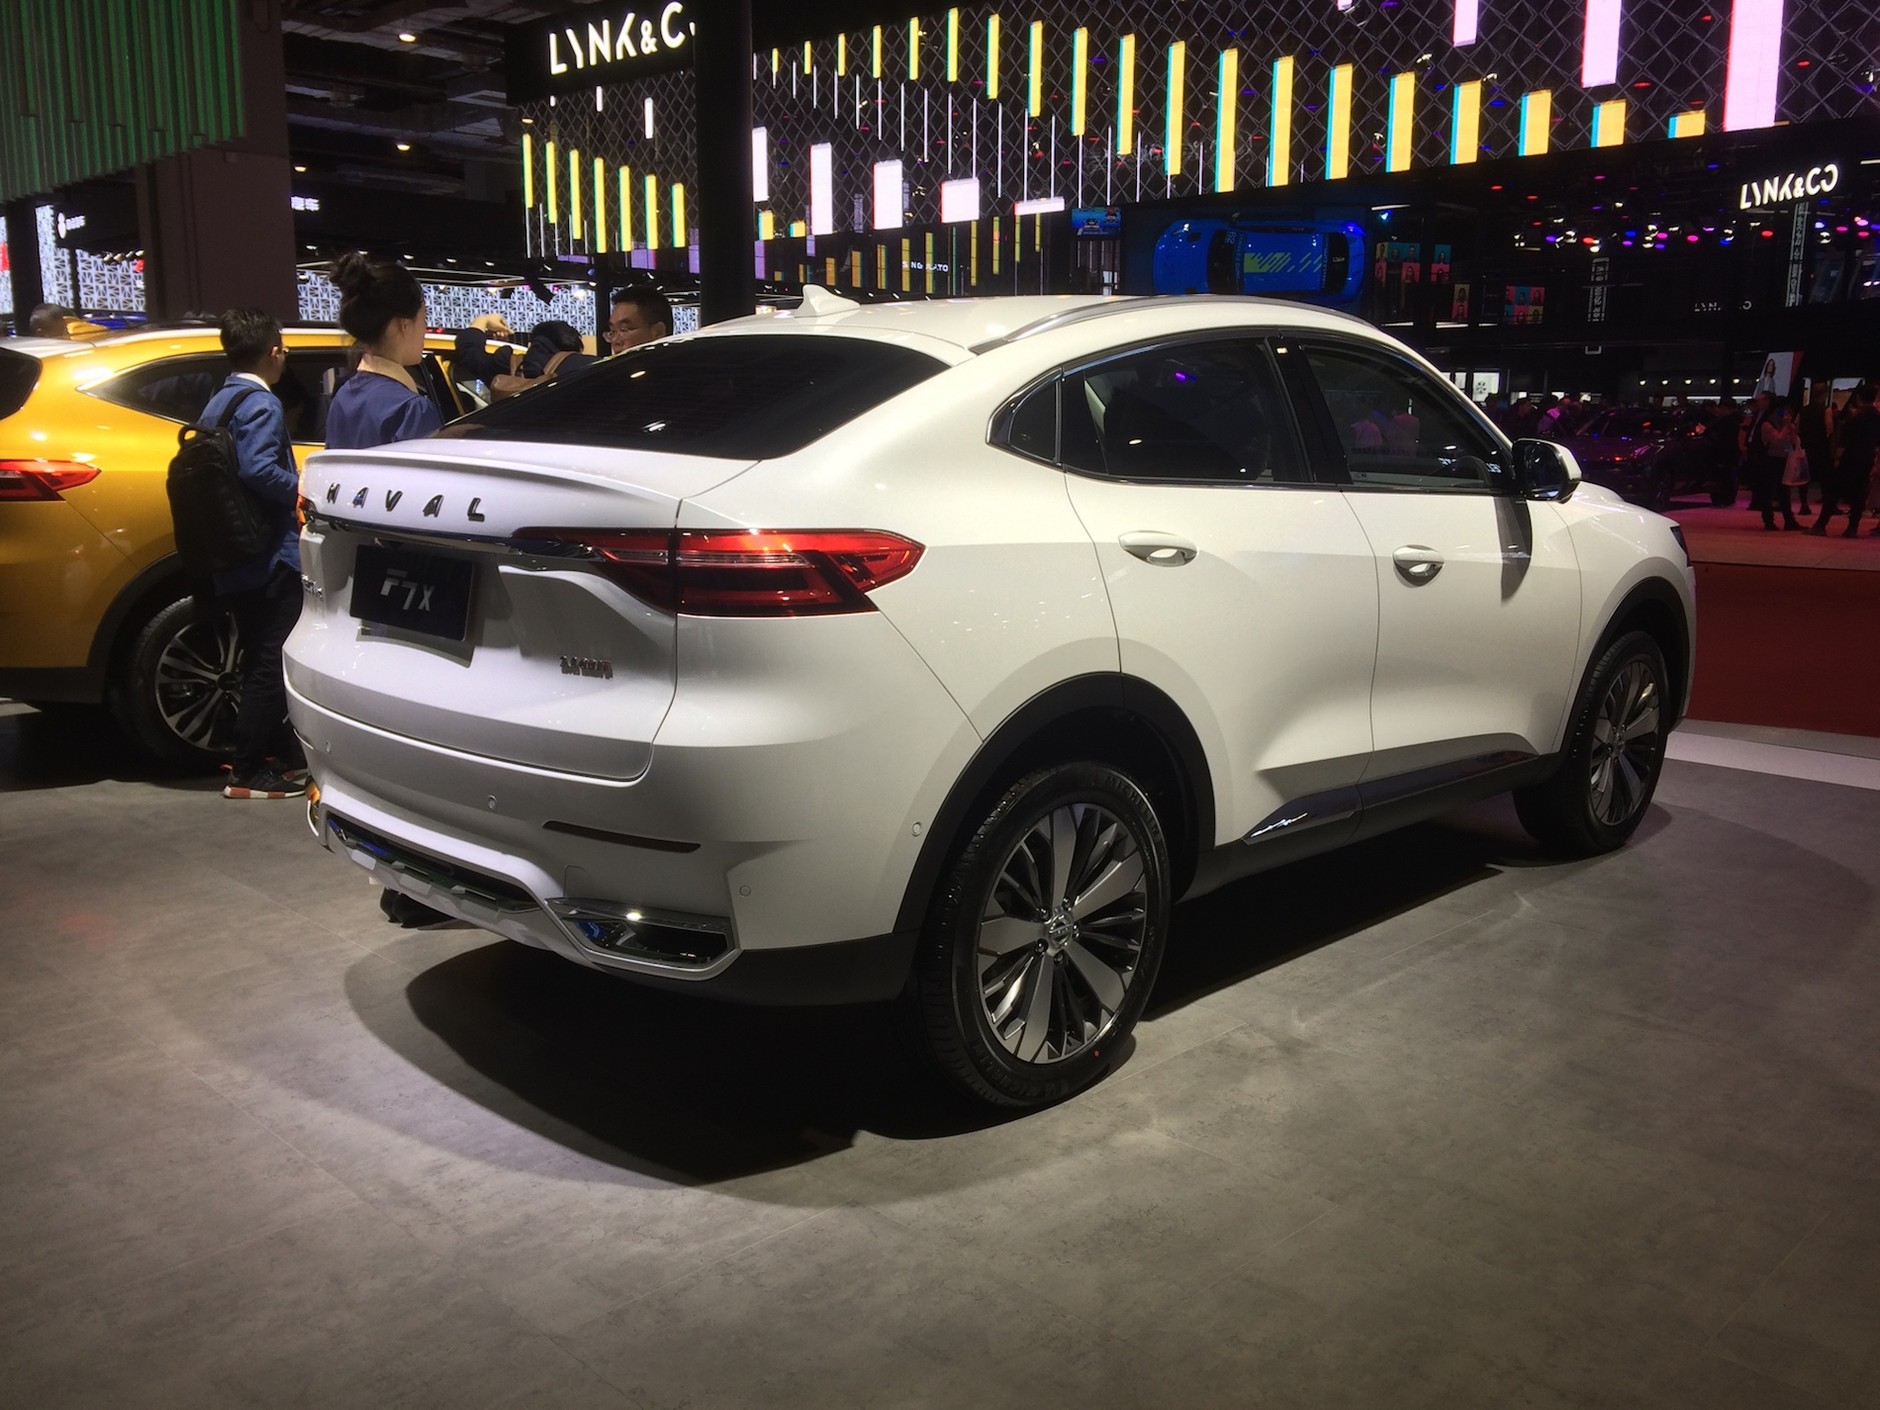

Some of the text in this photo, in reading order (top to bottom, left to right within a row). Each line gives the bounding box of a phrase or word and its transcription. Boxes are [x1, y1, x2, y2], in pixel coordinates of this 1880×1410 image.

[549, 1, 696, 75] LYNK&C
[1740, 163, 1839, 210] LYNK&CO
[326, 482, 486, 523] HAVAL
